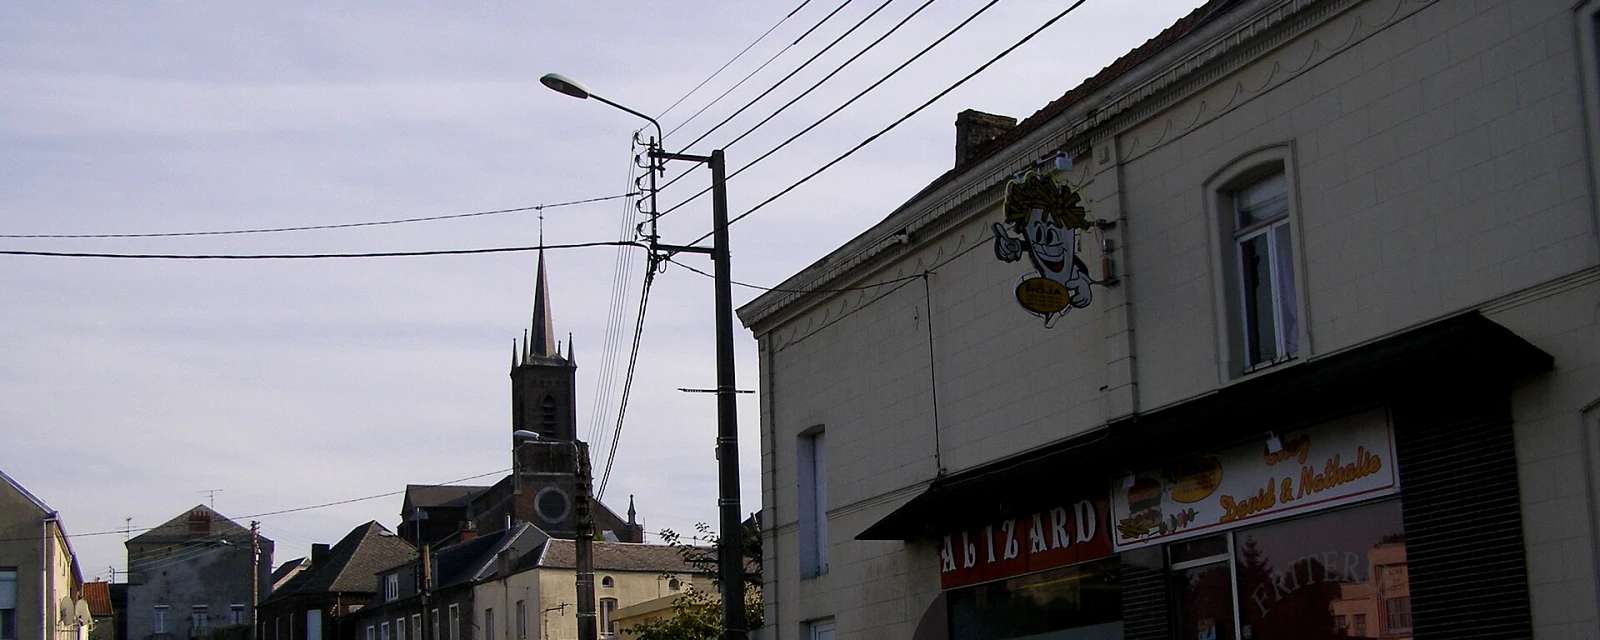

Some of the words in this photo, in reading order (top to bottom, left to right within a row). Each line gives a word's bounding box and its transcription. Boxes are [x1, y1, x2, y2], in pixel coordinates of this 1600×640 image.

[1220, 477, 1276, 524] David
[1280, 477, 1296, 504] &
[1297, 445, 1382, 500] Nathalie
